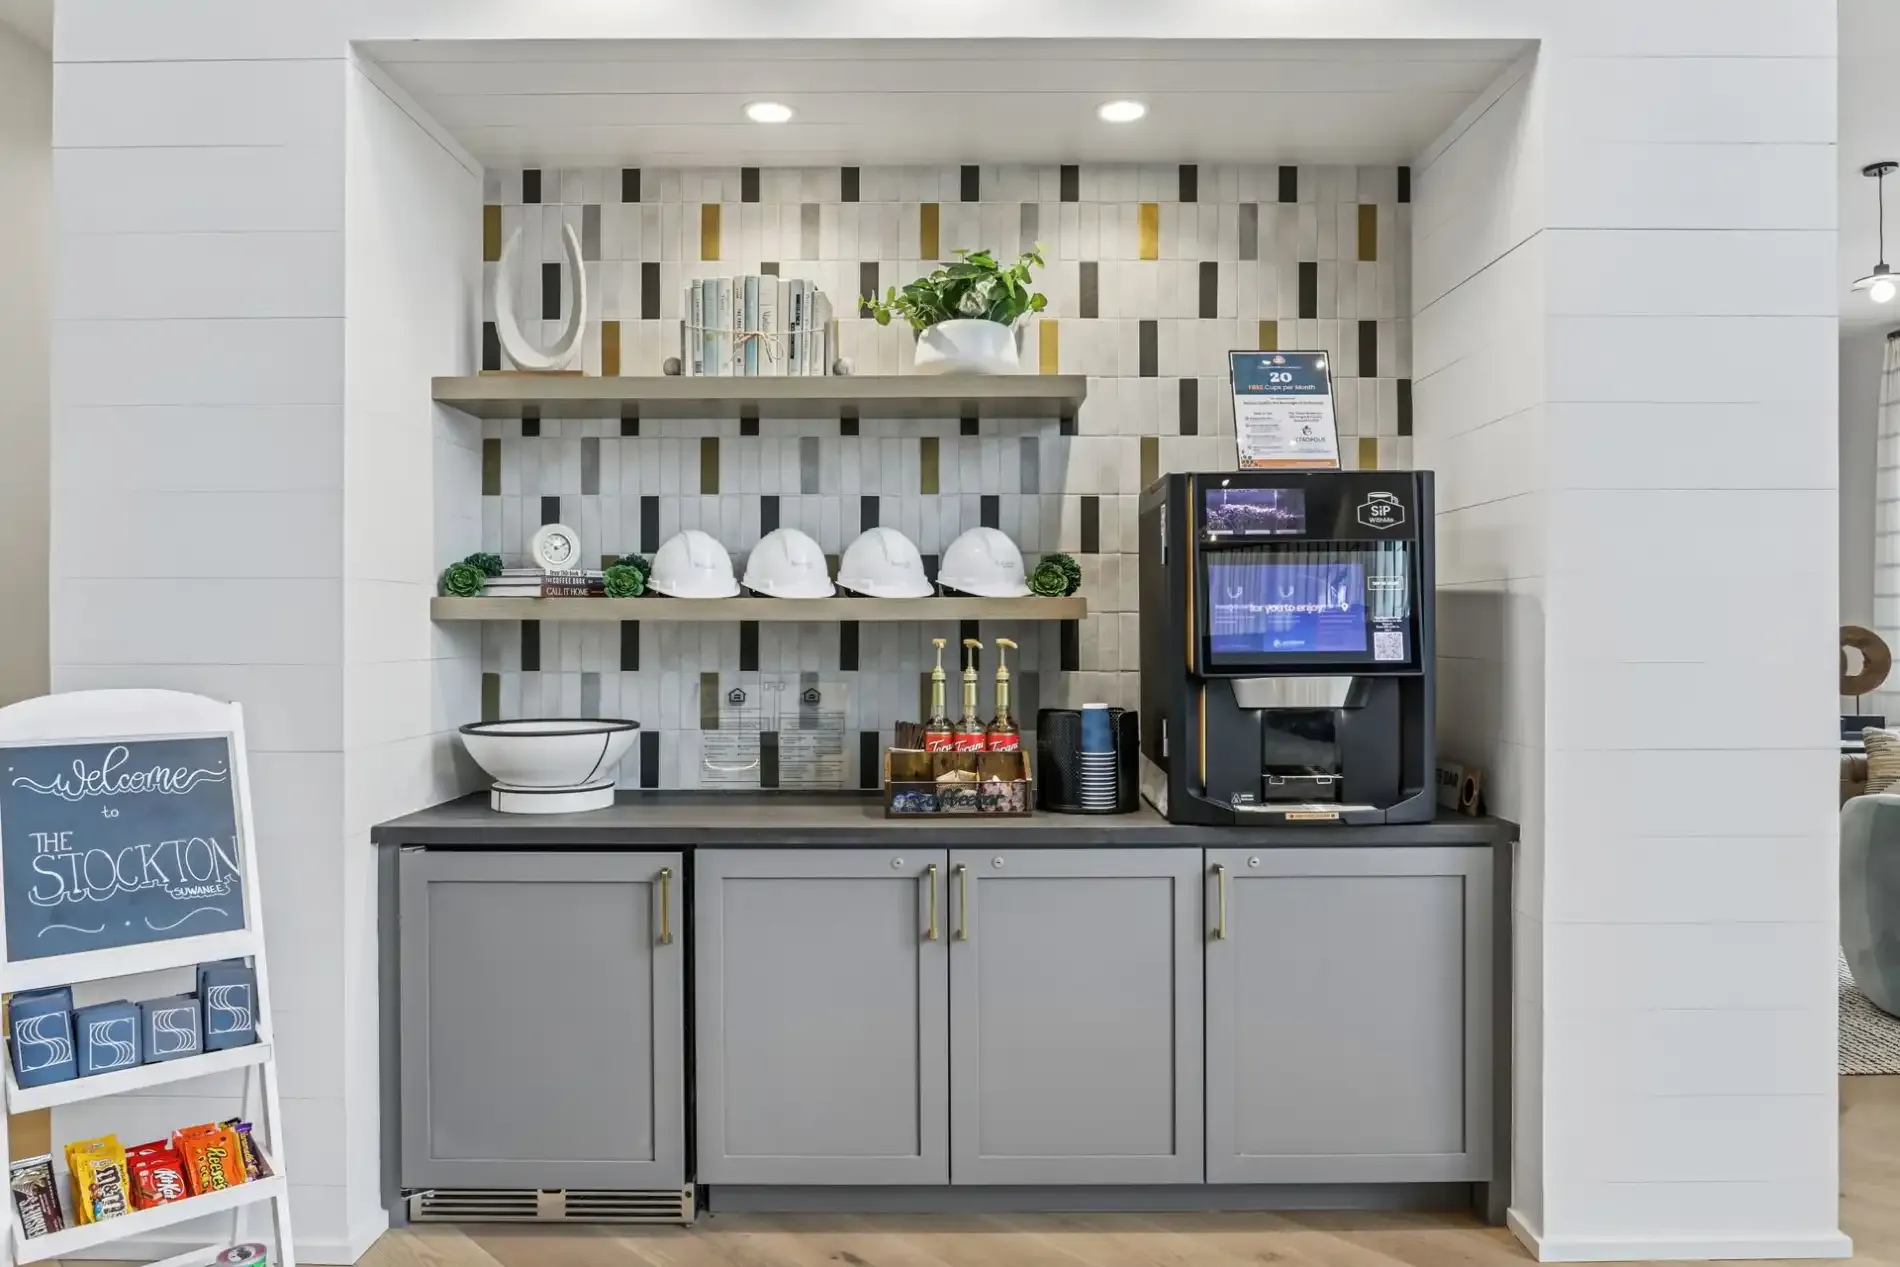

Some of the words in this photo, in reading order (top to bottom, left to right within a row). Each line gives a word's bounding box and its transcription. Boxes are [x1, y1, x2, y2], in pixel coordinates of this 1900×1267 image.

[1269, 372, 1293, 383] 20
[1264, 384, 1281, 392] Cups
[546, 587, 562, 596] CALL
[563, 587, 570, 596] IT
[570, 587, 589, 596] HOME
[101, 805, 119, 818] to
[28, 831, 74, 853] THE
[31, 836, 240, 901] STOCKTON
[173, 883, 225, 897] SUWANEE
[19, 1193, 49, 1240] ERSHEY'S
